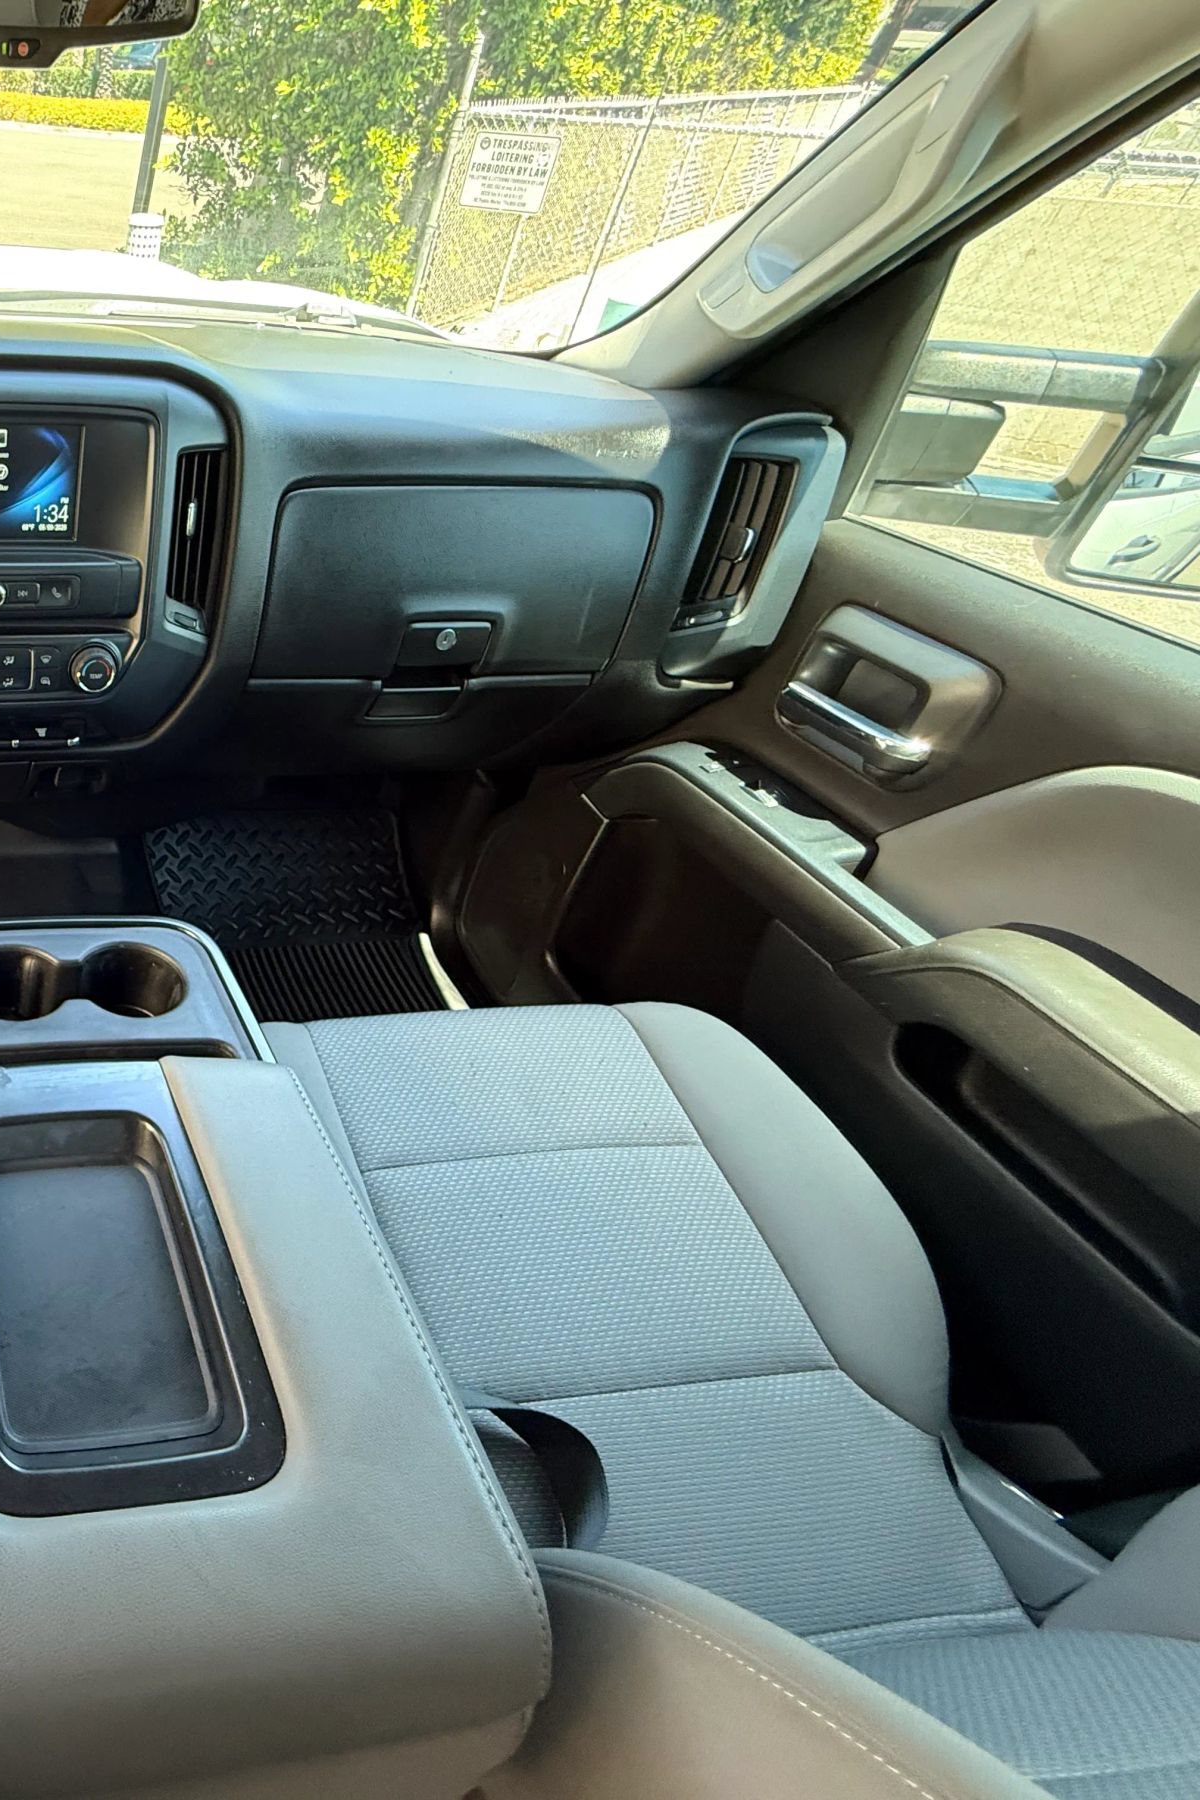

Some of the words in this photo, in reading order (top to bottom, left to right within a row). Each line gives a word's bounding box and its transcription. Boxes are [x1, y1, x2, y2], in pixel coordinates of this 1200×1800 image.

[492, 139, 550, 152] TRESPASSING
[491, 151, 534, 164] LOITERING
[471, 162, 516, 175] FORBIDDEN
[516, 166, 528, 176] BY
[529, 167, 548, 178] LAW
[33, 504, 69, 523] 1:34
